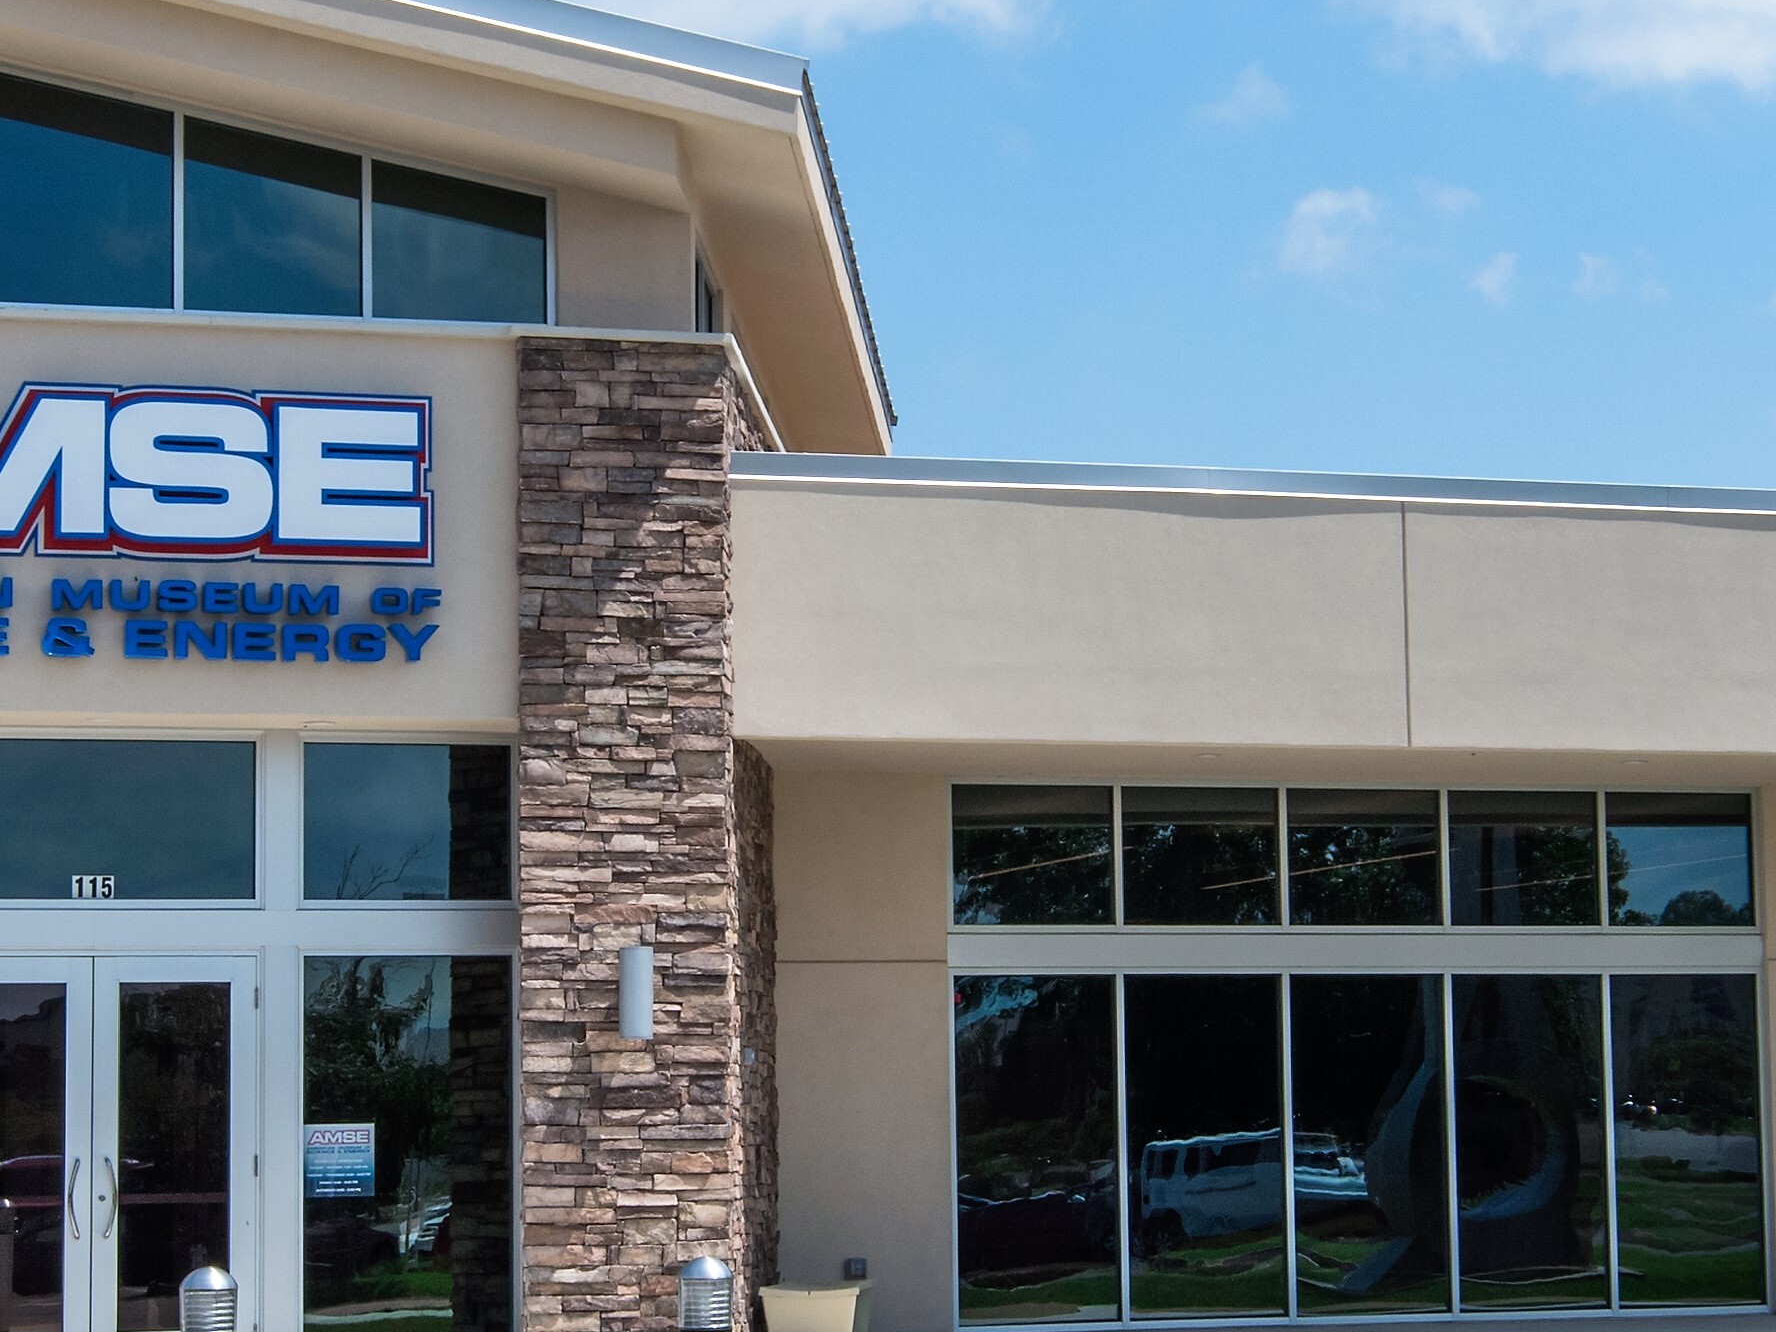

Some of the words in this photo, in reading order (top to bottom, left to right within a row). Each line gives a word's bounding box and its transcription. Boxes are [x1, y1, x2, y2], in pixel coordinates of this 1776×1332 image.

[51, 578, 339, 615] MUSEUM
[370, 587, 442, 615] OF
[41, 617, 95, 658] &
[124, 619, 440, 662] ENERGY
[75, 876, 113, 899] 115
[308, 1130, 370, 1145] AMSE
